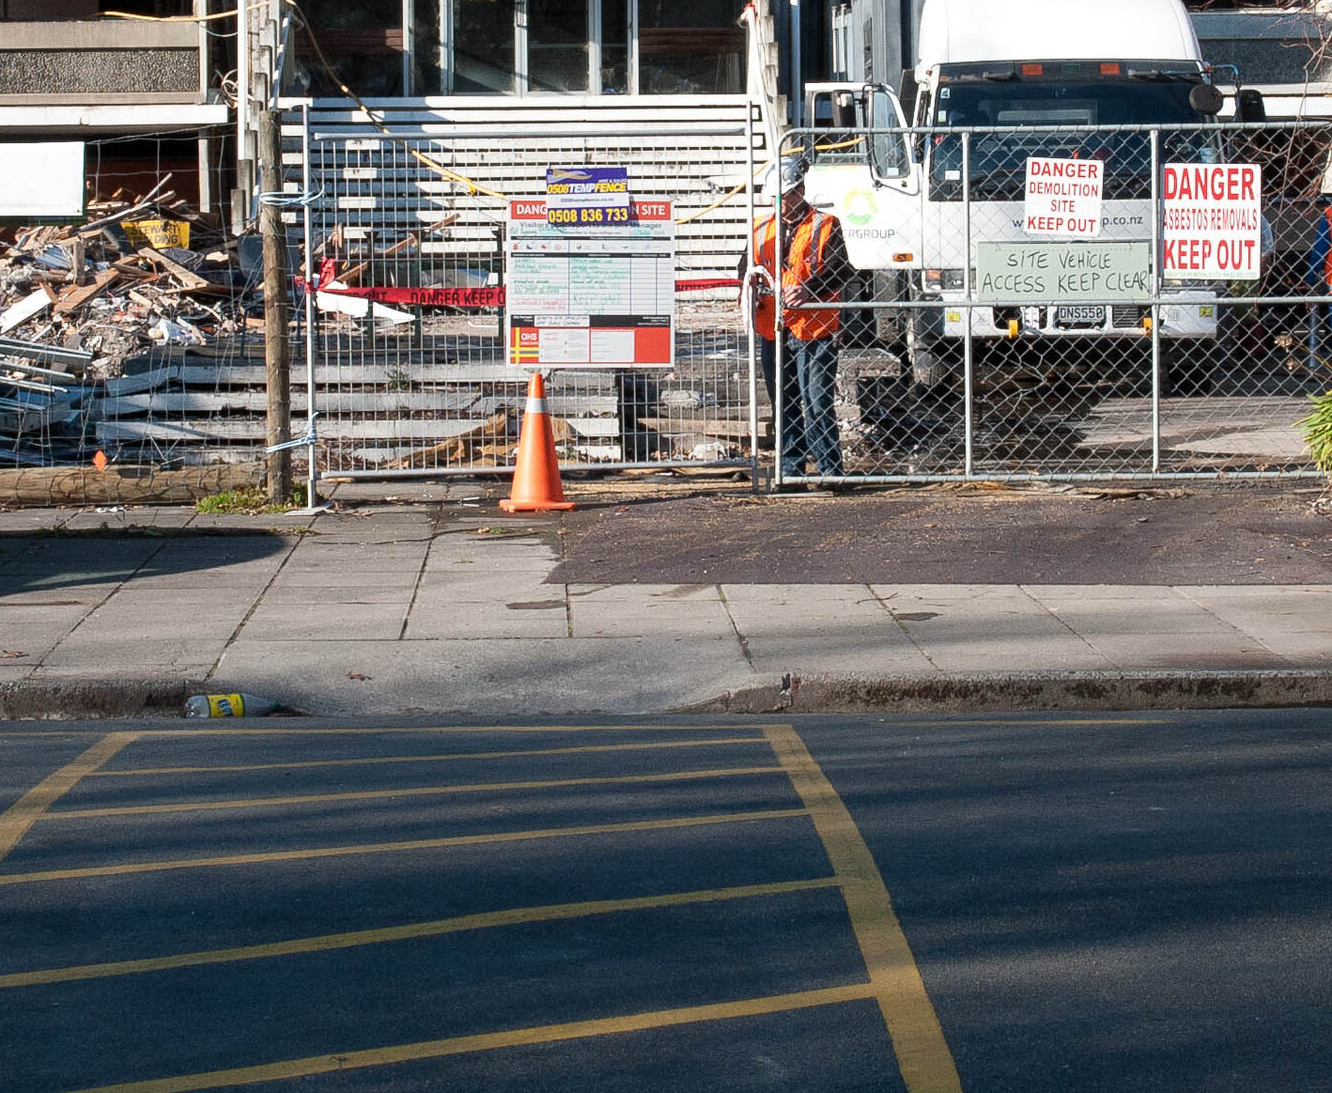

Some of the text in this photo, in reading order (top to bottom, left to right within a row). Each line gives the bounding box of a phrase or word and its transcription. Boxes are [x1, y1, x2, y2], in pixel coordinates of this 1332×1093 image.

[1031, 161, 1098, 179] DANGER
[1029, 181, 1099, 197] DEMOLITION
[1164, 167, 1255, 201] DANGER
[516, 204, 548, 215] DANG
[642, 204, 666, 216] SITE
[1050, 199, 1076, 213] SITE
[548, 209, 578, 223] 0508
[580, 208, 603, 222] 836
[606, 207, 629, 222] 733
[1163, 208, 1258, 231] ASBESTOS REMOVALS
[1028, 215, 1064, 231] KEEP
[1067, 217, 1097, 233] OUT
[1163, 239, 1256, 270] KEEP OUT
[981, 272, 1046, 294] ACCESS
[1058, 271, 1101, 294] KEEP
[410, 291, 460, 305] DANGER
[463, 290, 495, 305] KEEP
[1060, 307, 1103, 319] DNS550
